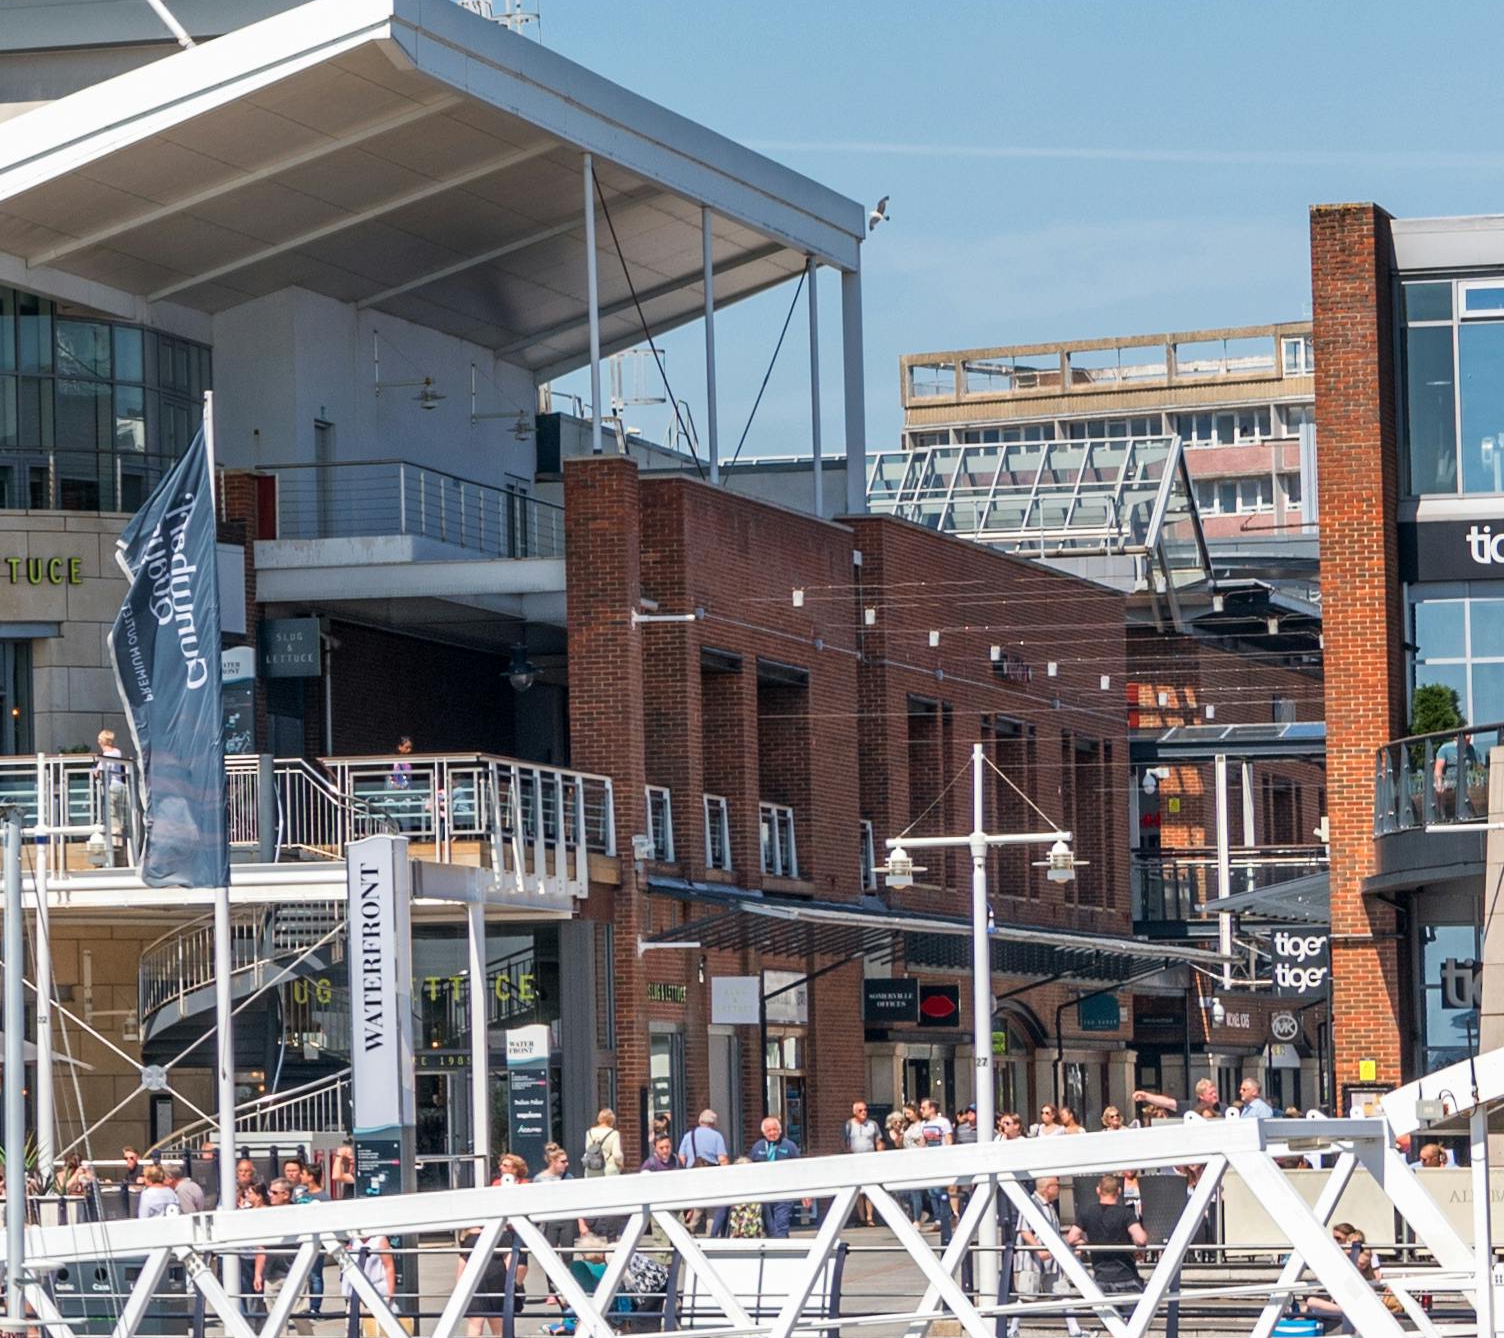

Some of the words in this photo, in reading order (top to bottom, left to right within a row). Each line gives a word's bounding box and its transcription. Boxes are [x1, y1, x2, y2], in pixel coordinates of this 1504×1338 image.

[276, 632, 304, 642] SLUG
[266, 653, 314, 664] LETTUCE
[1274, 931, 1328, 962] tiger
[363, 862, 382, 1055] WATERFRONT
[1274, 963, 1328, 993] tiger
[976, 1057, 988, 1067] 27
